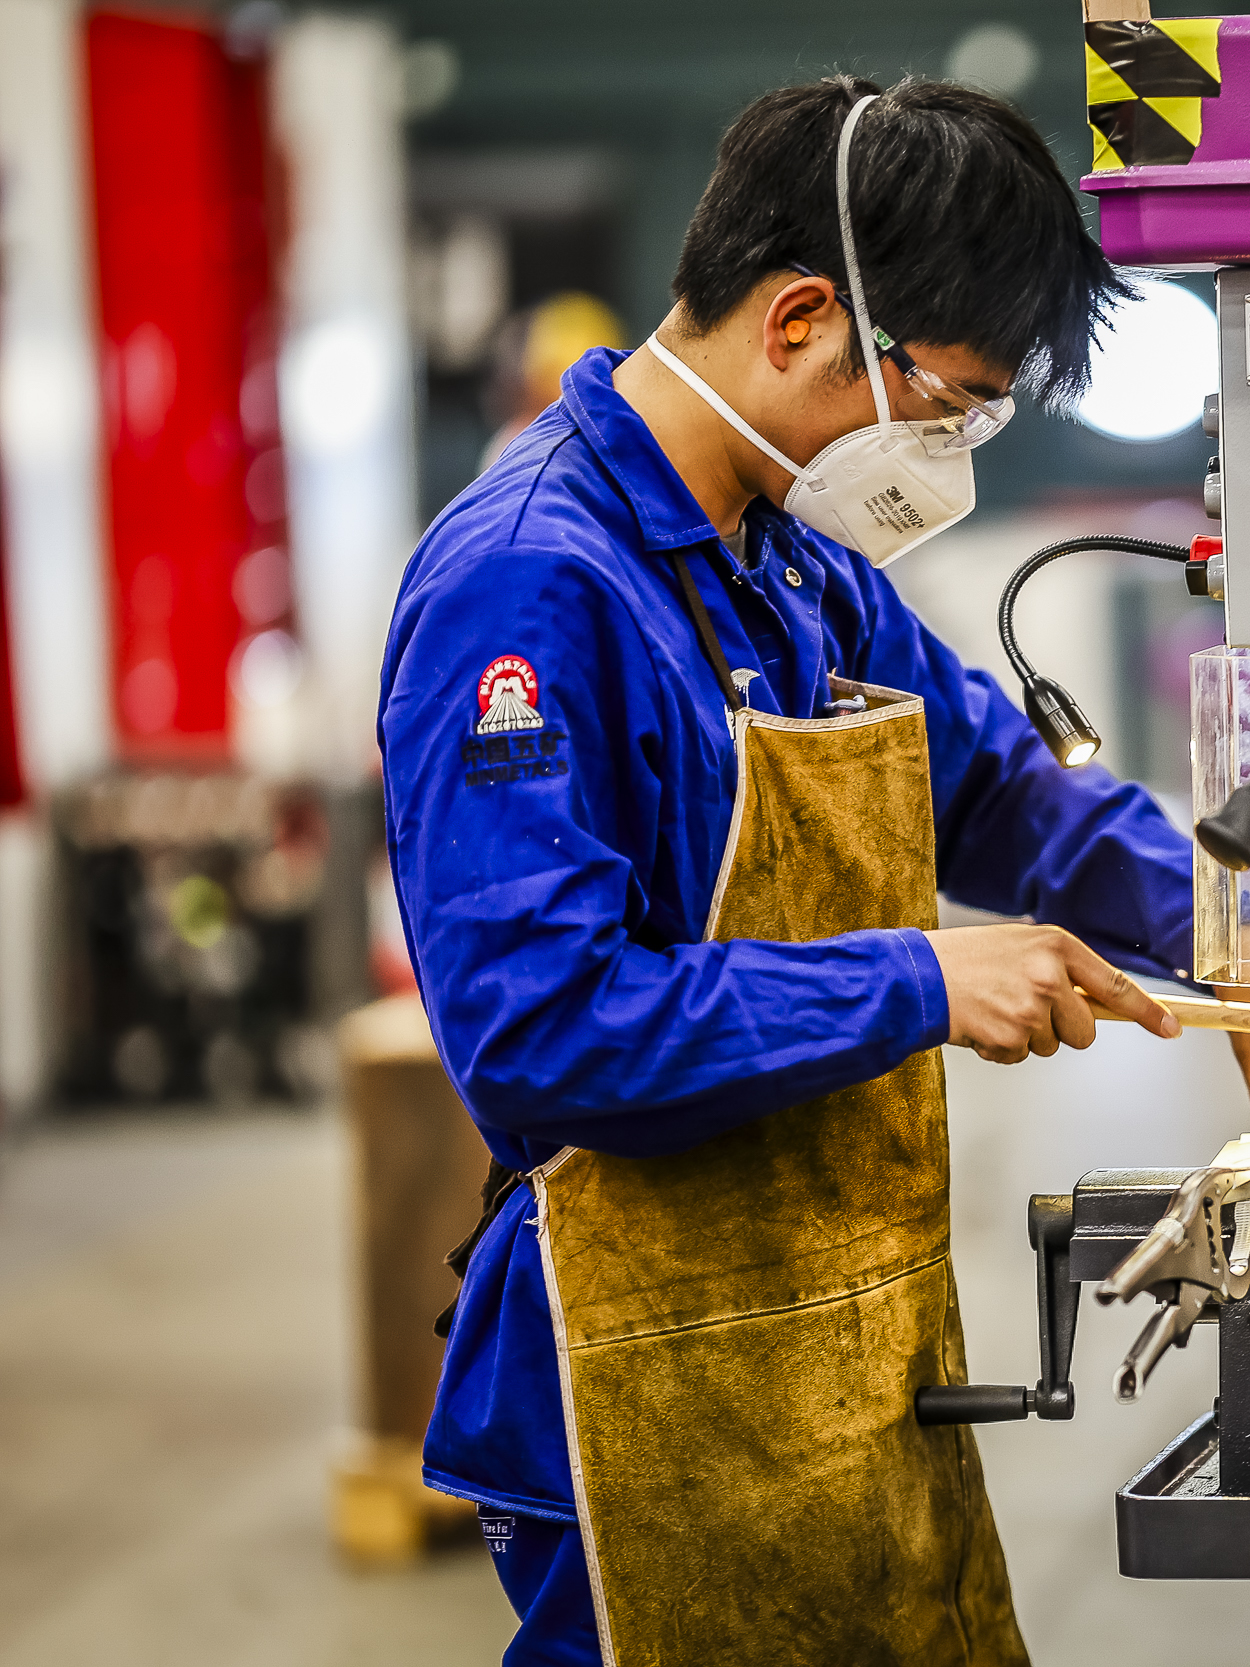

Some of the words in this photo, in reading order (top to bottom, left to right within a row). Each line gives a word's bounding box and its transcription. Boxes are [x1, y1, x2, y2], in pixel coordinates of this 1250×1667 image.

[886, 486, 905, 503] 3M
[900, 504, 925, 528] 9502+
[480, 659, 537, 695] MINMETALS
[465, 760, 568, 787] MINMETALS
